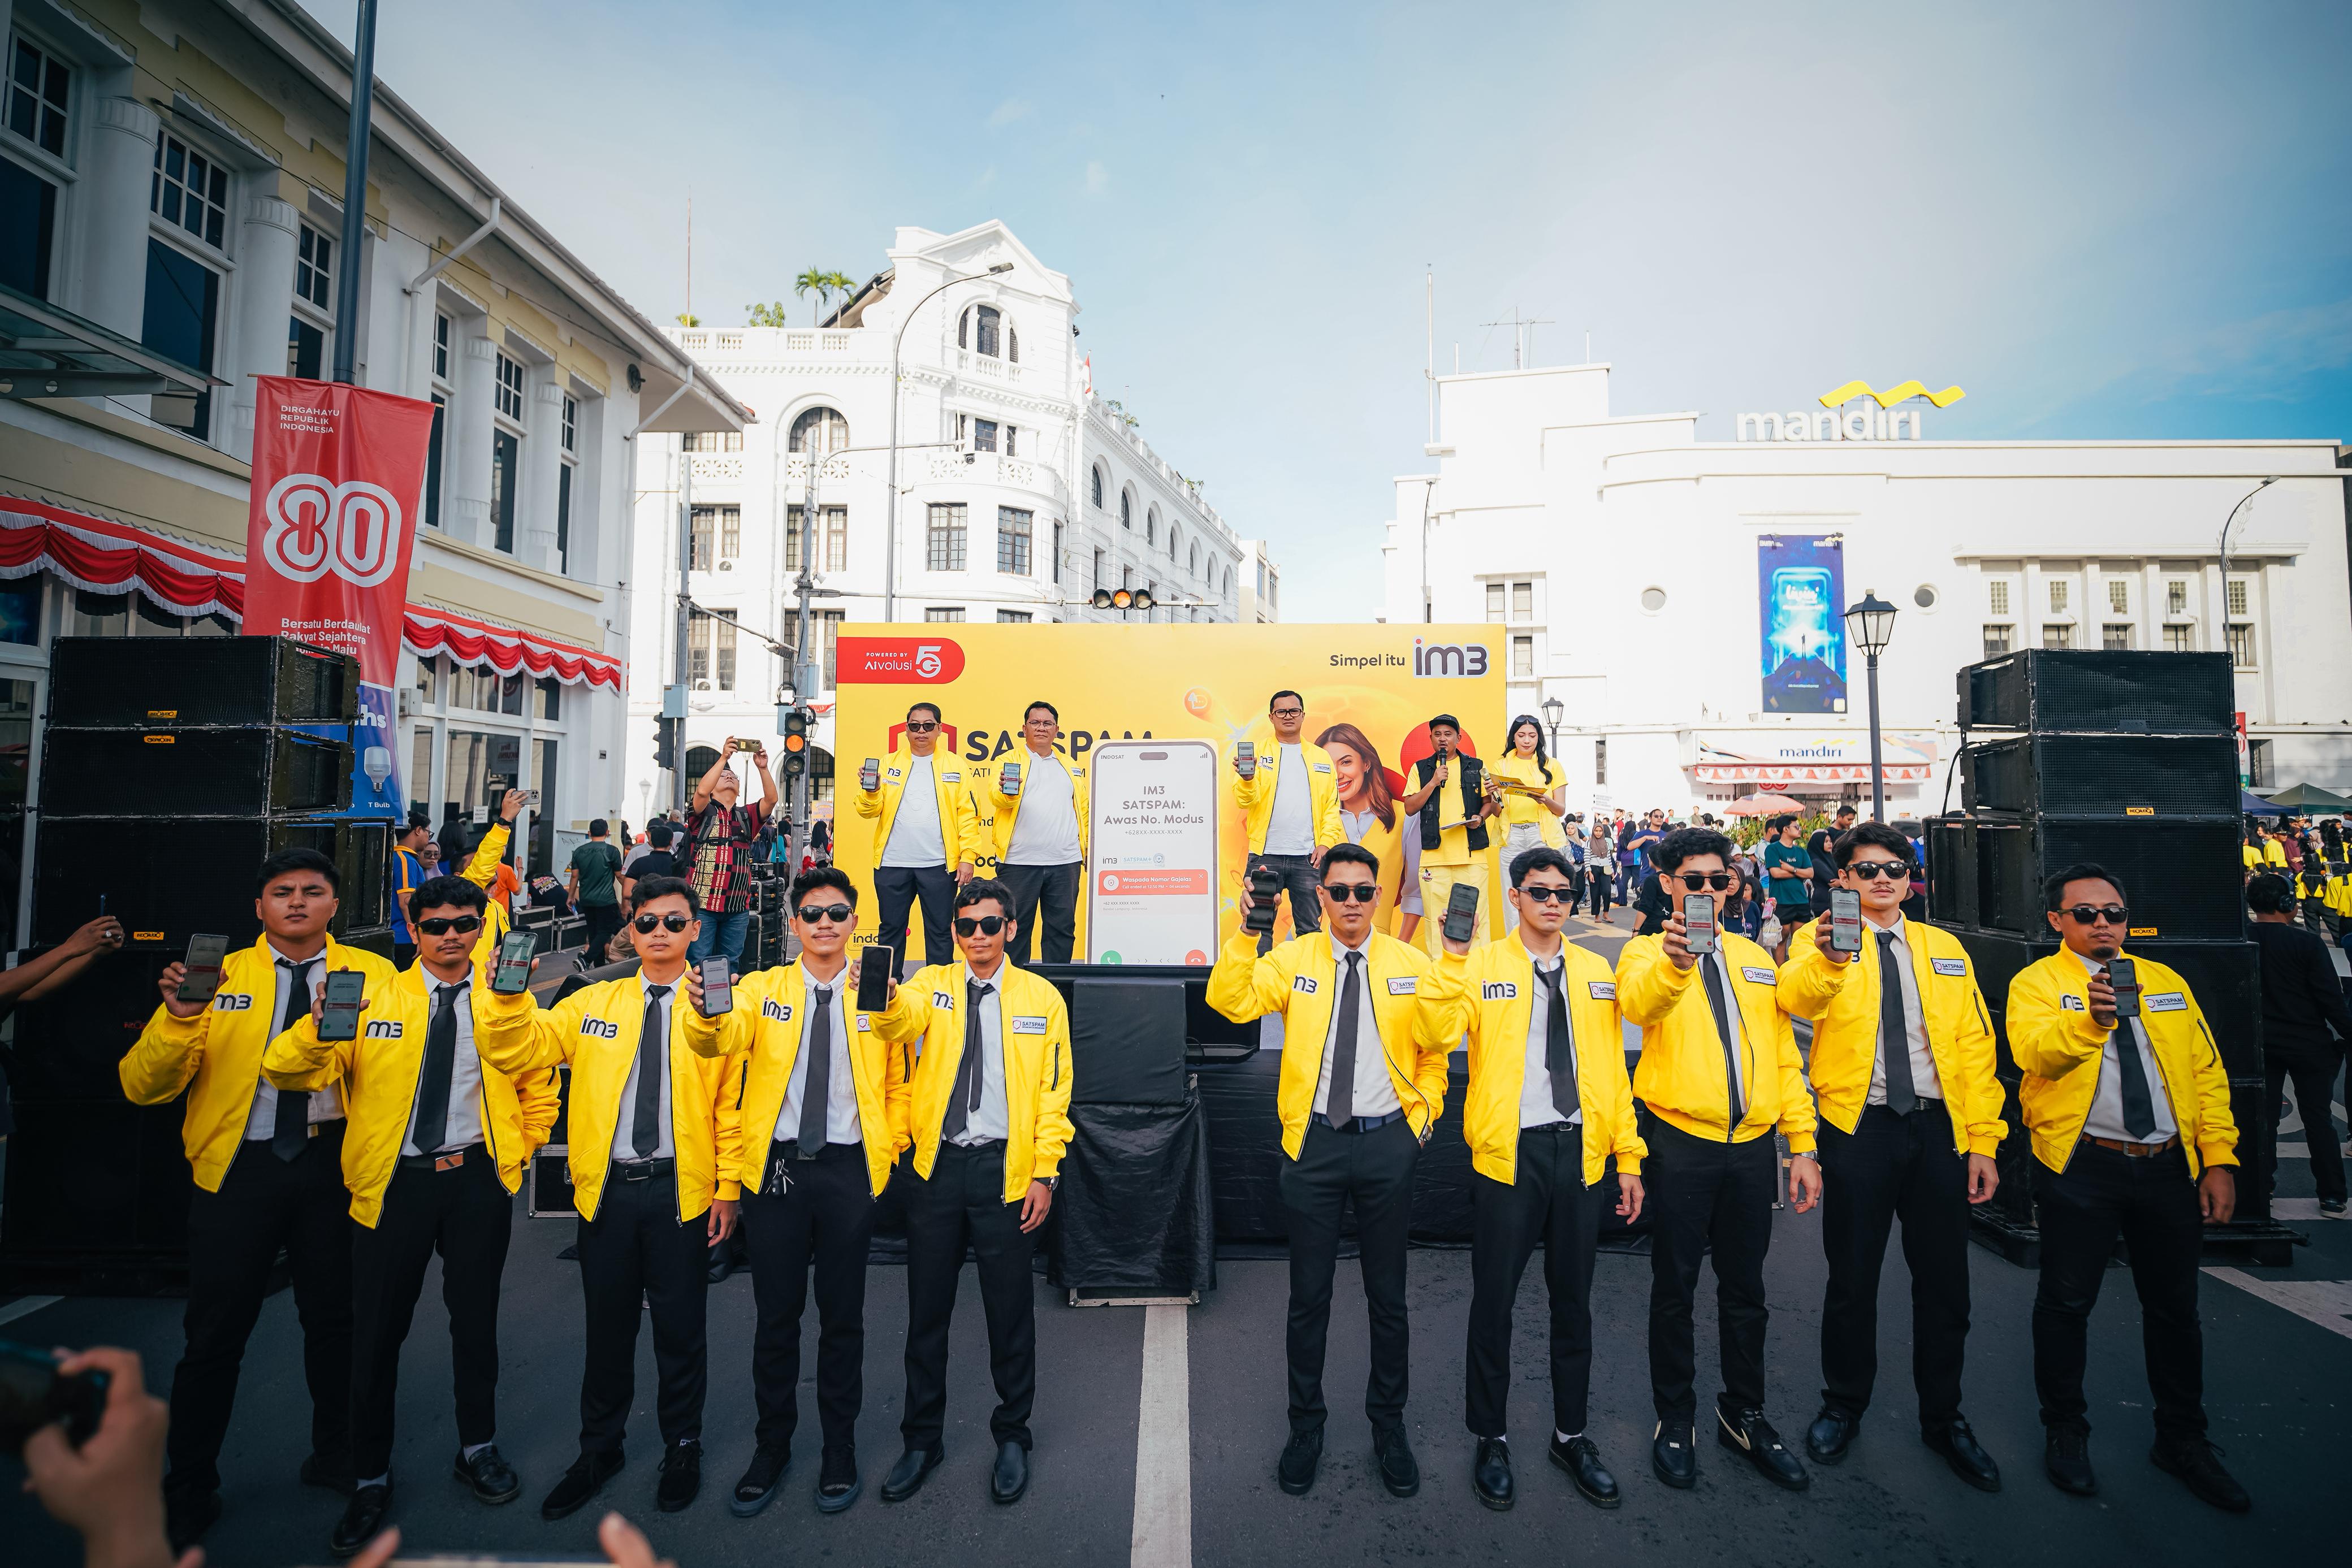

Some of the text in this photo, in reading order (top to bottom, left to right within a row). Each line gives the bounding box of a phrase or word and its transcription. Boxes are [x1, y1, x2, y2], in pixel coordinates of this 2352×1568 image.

[280, 405, 340, 417] DIRGAHAYU
[280, 414, 329, 425] REPUBLIK
[1737, 399, 1921, 441] mandiri
[280, 423, 334, 433] INDONESIA
[263, 473, 402, 587] 80
[281, 618, 371, 634] Bersatu Berdaulat
[281, 631, 366, 645] Rakyat Sejahtera
[332, 644, 357, 655] Maju
[1330, 638, 1487, 675] Simpel itu im3
[1780, 746, 1841, 757] mandiri
[1143, 786, 1165, 795] IM3
[1122, 800, 1185, 809] SATSPAM:
[1104, 814, 1204, 824] Awas No. Modus
[1483, 980, 1516, 999] im3
[215, 993, 252, 1010] m3
[763, 997, 792, 1021] im3
[366, 1021, 402, 1038] m3
[581, 1014, 618, 1038] im3
